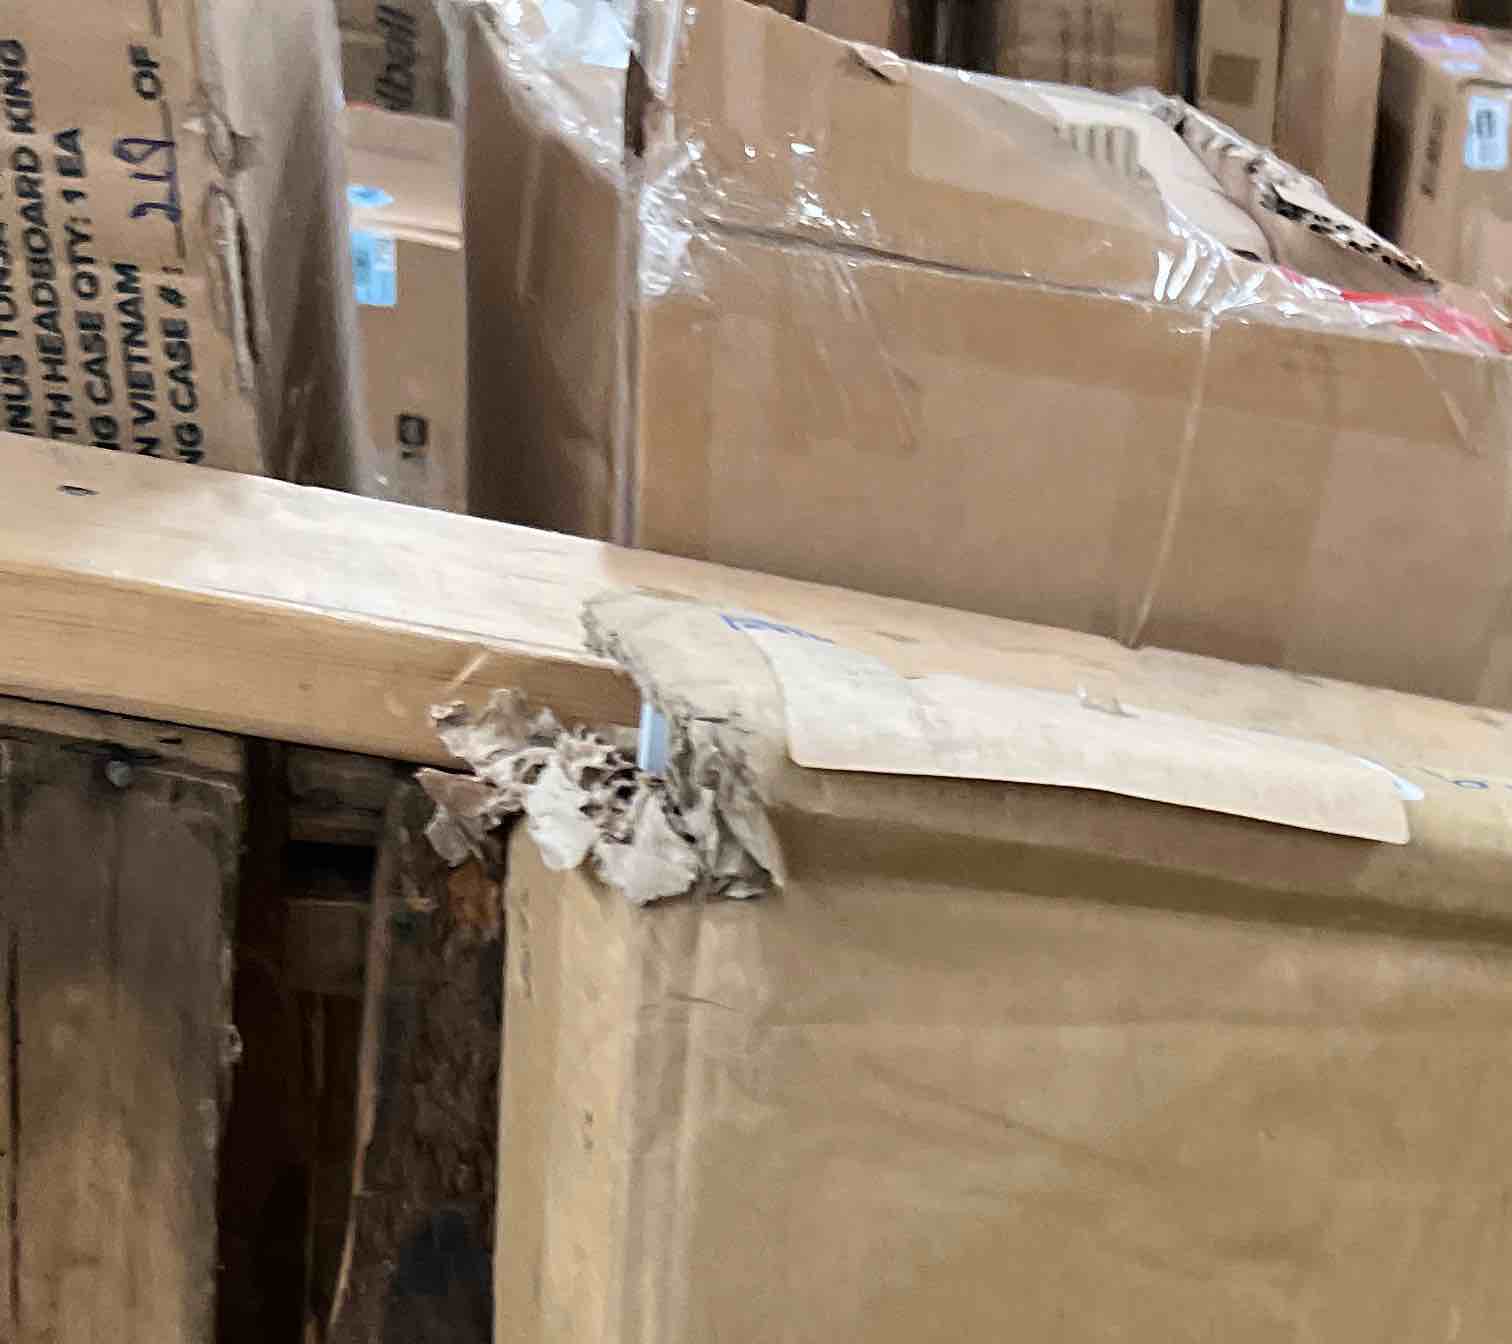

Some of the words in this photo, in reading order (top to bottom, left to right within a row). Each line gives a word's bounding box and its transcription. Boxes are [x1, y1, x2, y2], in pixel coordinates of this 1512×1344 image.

[0, 39, 34, 135] KING
[127, 44, 162, 101] OF
[52, 127, 87, 178] EA
[60, 189, 87, 203] 1
[12, 146, 68, 383] HEADBOARD
[64, 216, 99, 298] QTY:
[75, 310, 112, 405] CASE
[112, 263, 156, 425] VIETNAM
[159, 318, 198, 413] CASE
